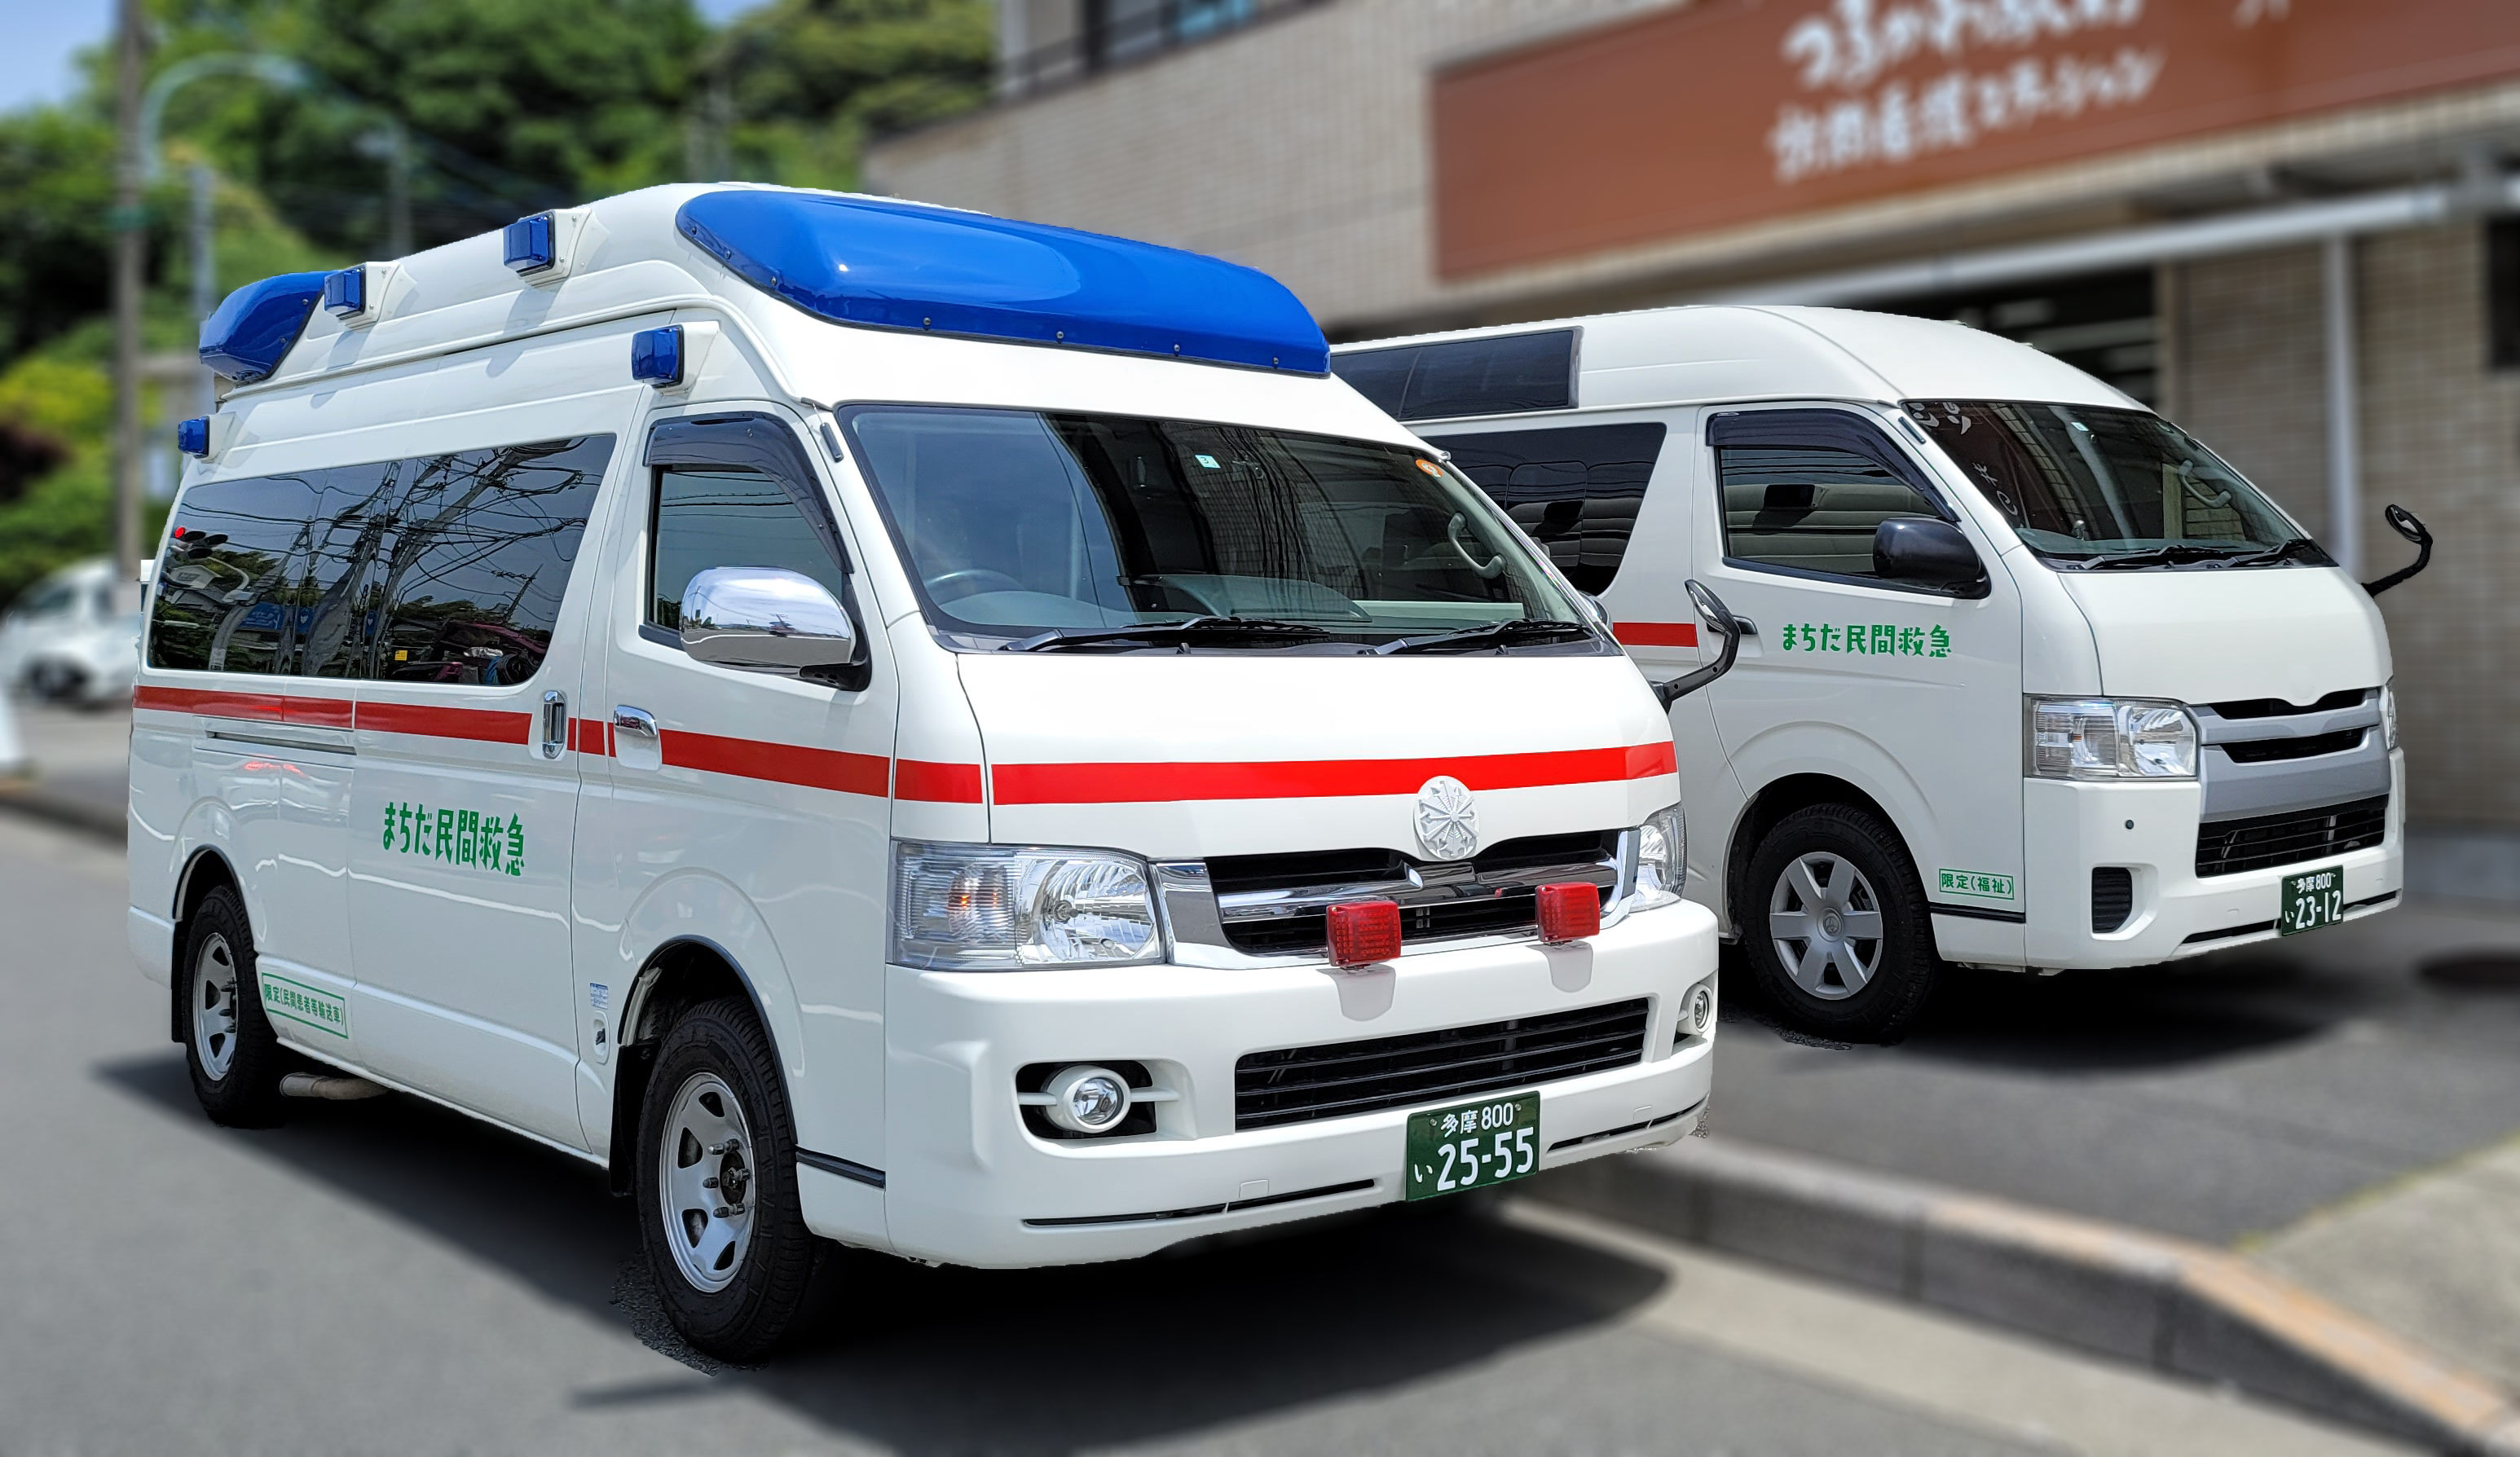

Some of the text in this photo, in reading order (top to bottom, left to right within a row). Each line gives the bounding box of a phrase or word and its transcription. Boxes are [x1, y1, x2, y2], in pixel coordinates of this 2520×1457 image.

[1782, 623, 1952, 658] まちだ民間救急
[383, 801, 525, 877] まちだ民間救急
[1941, 873, 2012, 895] 限定(福祉)
[2297, 872, 2332, 894] 多摩 800
[2284, 890, 2342, 929] い 23-12
[1440, 1103, 1513, 1138] 多摩 800
[1414, 1126, 1535, 1192] い 25-55
